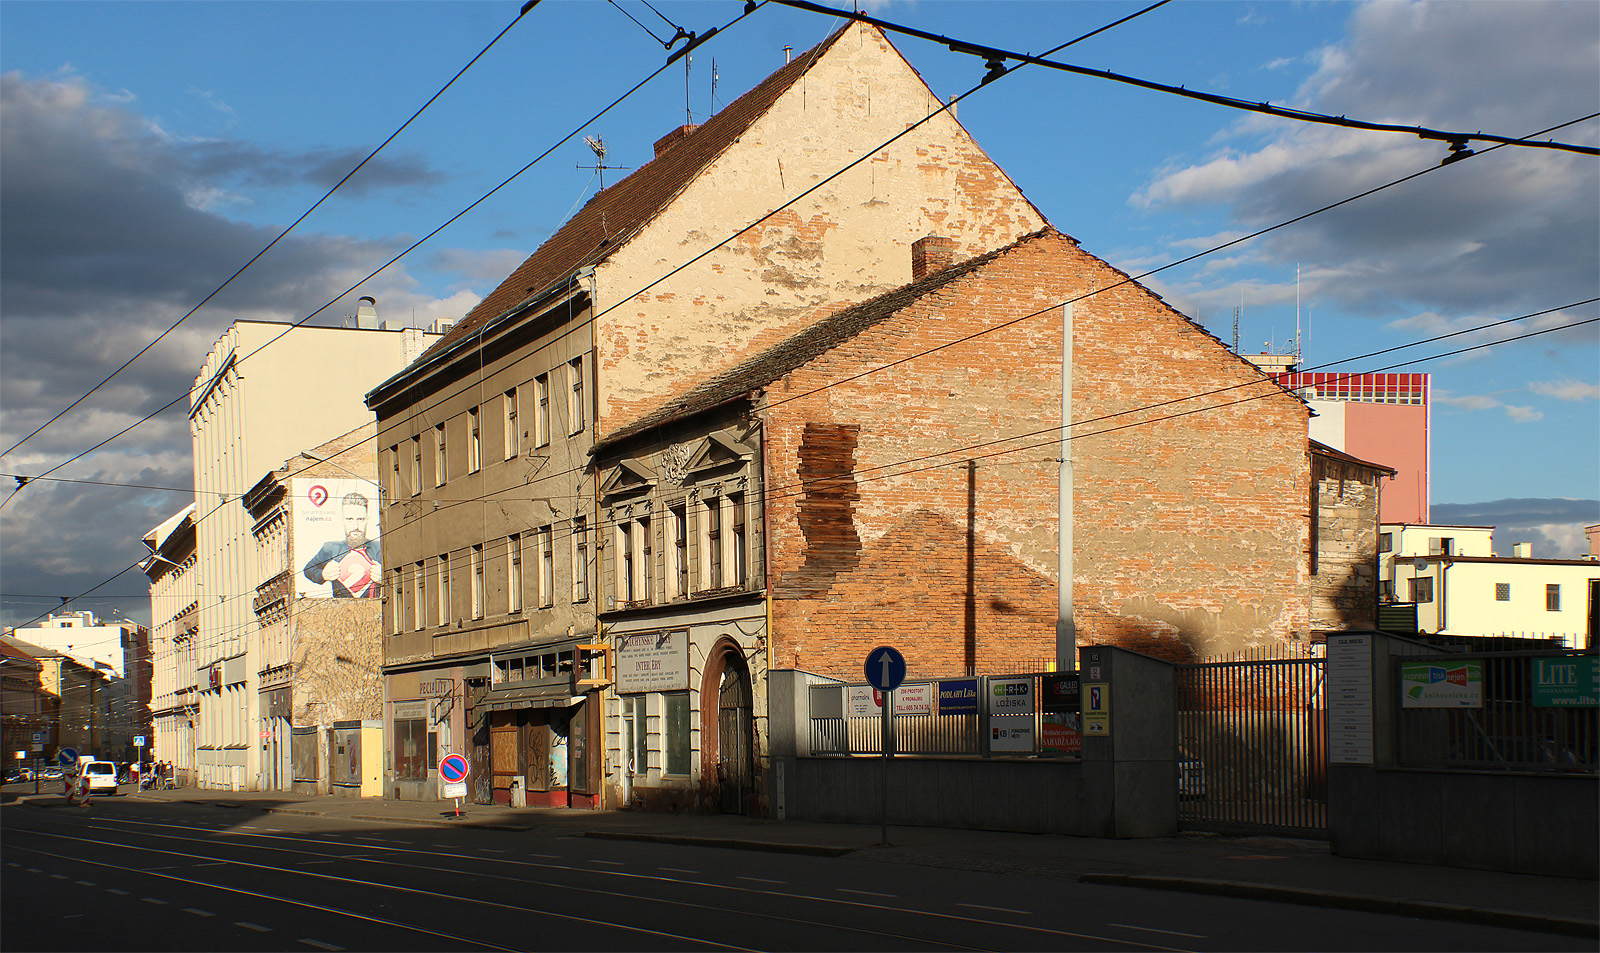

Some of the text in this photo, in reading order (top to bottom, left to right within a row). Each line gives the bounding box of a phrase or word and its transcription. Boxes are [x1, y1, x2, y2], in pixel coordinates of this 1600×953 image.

[1433, 671, 1446, 680] tisk
[1537, 660, 1577, 684] LITE
[995, 697, 1026, 708] LOŽISKA
